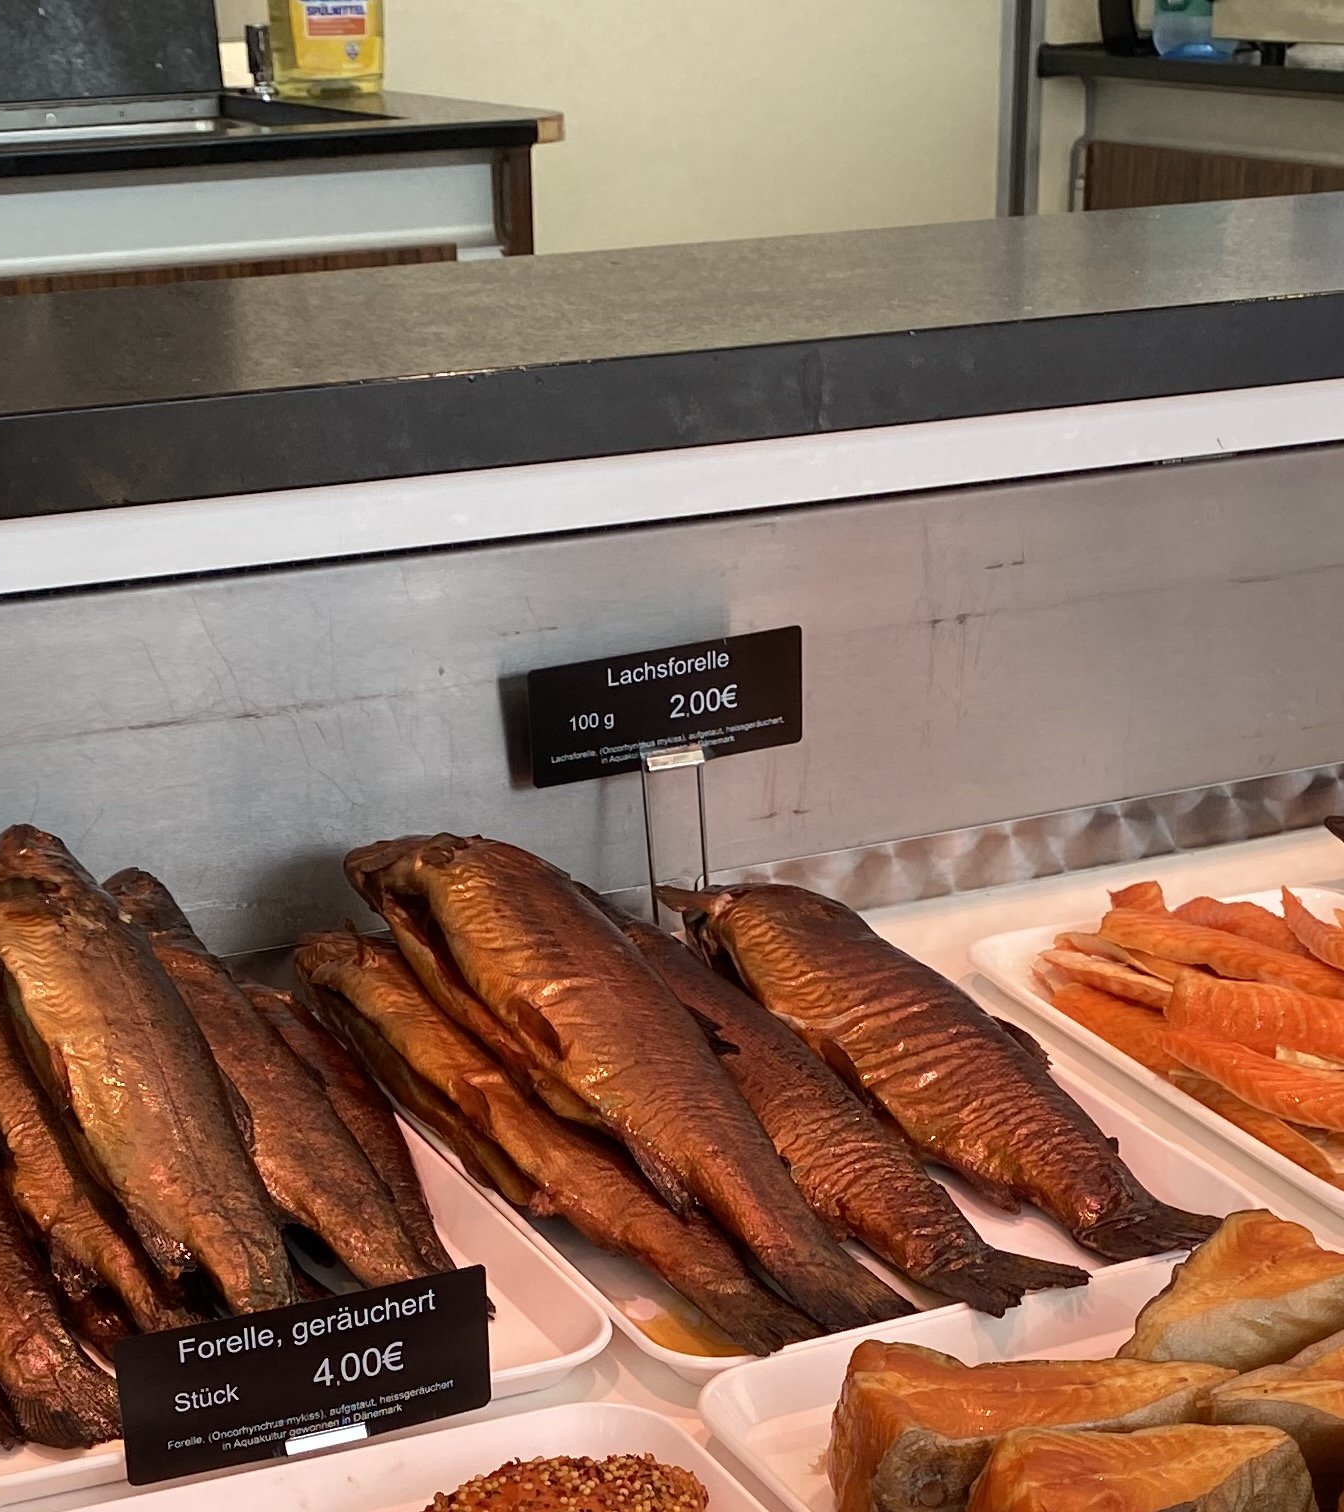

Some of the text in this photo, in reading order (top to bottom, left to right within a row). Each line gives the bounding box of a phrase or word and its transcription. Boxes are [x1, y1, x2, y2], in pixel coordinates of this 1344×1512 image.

[608, 651, 729, 686] Lachsforelle
[670, 684, 737, 718] 2,00€
[570, 713, 614, 730] 100 g
[179, 1289, 435, 1363] Forelle, geräuchert
[314, 1342, 403, 1386] 4,00€
[175, 1384, 239, 1412] Stück
[222, 1404, 402, 1450] in Aquakultur gewonnen in Dänemark
